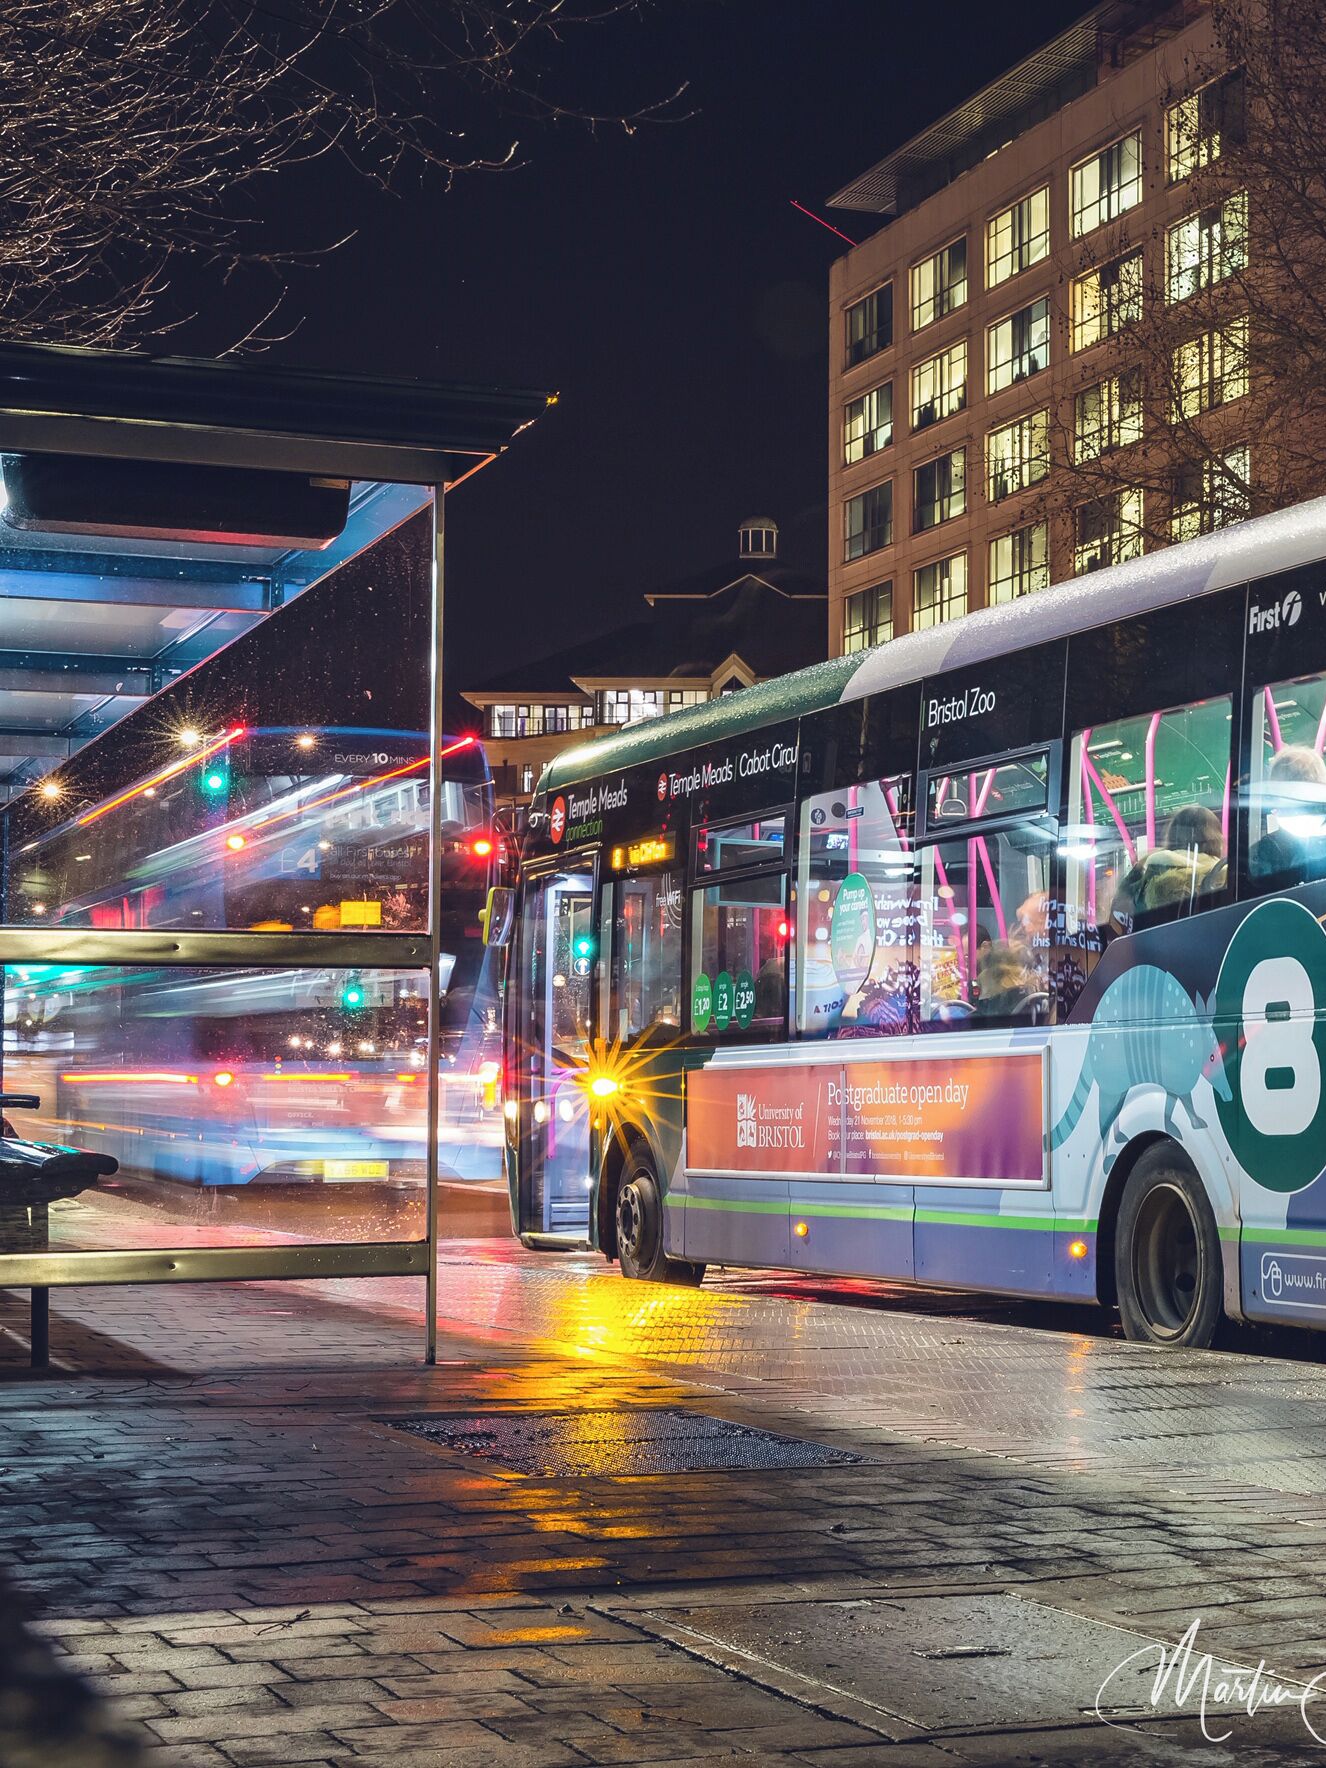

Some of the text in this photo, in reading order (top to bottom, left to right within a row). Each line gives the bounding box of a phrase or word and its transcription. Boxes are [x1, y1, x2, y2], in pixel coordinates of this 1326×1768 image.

[1249, 599, 1281, 635] First
[928, 687, 996, 728] Bristol Zoo
[334, 752, 416, 766] EVERY 10 MINS
[668, 743, 798, 798] Temple Meads Cabot Circu
[568, 779, 628, 822] Temple Meads
[566, 818, 602, 841] connection
[279, 848, 318, 873] £4
[718, 993, 728, 1011] £2
[1240, 956, 1321, 1135] 8
[828, 1077, 969, 1111] Postgraduate open day
[758, 1102, 804, 1125] University of
[828, 1115, 854, 1127] Wednday
[758, 1125, 805, 1148] BRISTOL
[828, 1130, 840, 1140] Book
